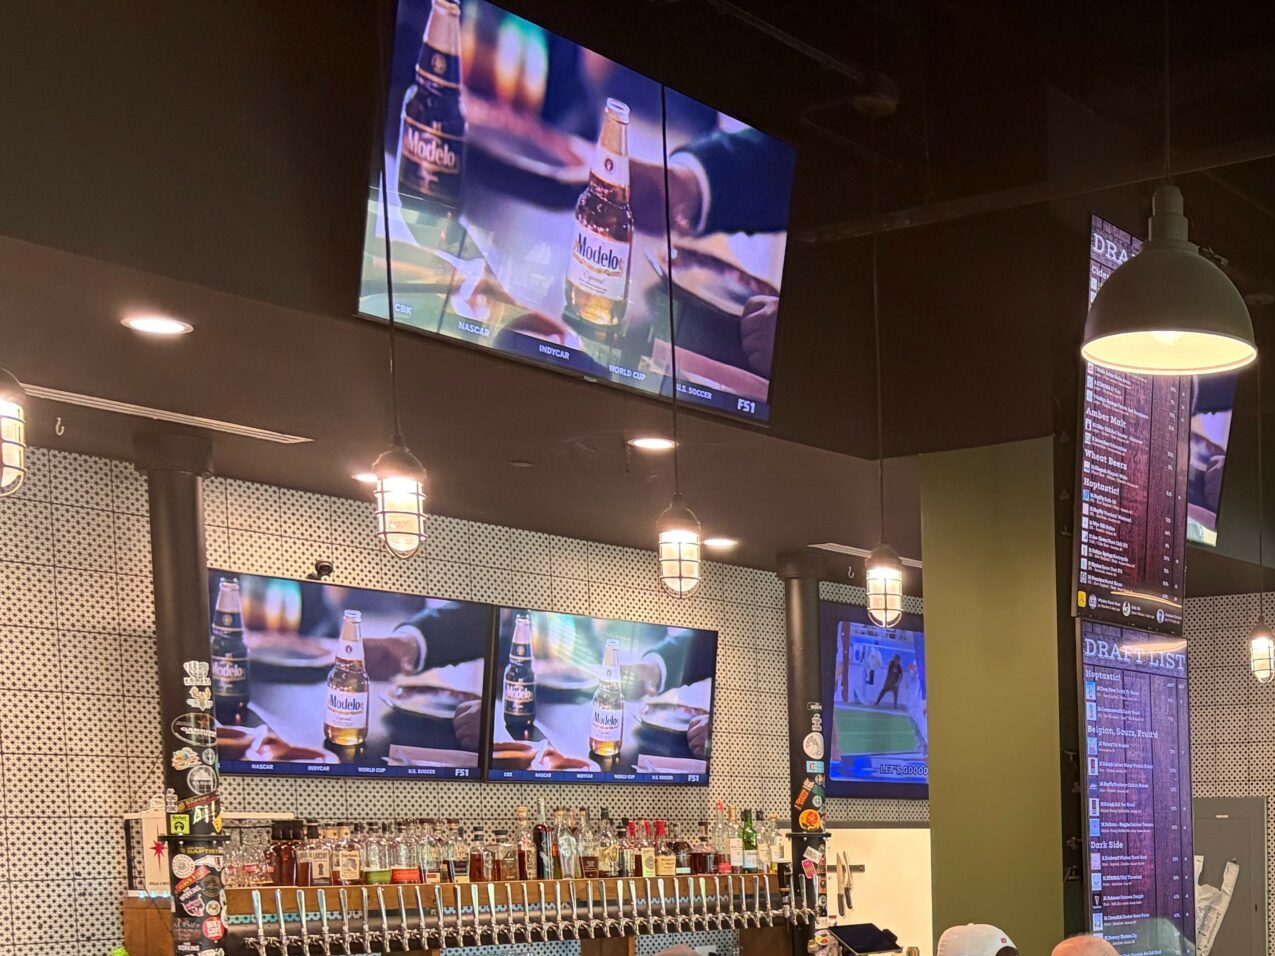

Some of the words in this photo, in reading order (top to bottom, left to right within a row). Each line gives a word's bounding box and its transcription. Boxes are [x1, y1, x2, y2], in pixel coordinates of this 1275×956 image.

[408, 127, 455, 168] Modelo
[578, 233, 619, 270] Modelo
[395, 303, 413, 315] CBK
[459, 321, 490, 337] NASCAR
[539, 344, 570, 360] INDYCAR
[609, 364, 632, 378] WORLD
[632, 369, 646, 381] CUP
[688, 387, 713, 400] SOCCER
[737, 398, 756, 414] FS1
[1085, 449, 1108, 465] Wheat
[1083, 477, 1120, 496] Hoptastic!
[1084, 638, 1143, 665] DRAFT
[1150, 652, 1186, 670] LIST
[1085, 669, 1122, 682] Hoptastic!
[506, 684, 532, 700] Modelo
[331, 694, 361, 711] Modelo
[594, 712, 618, 725] Modelo
[455, 768, 469, 777] FS1
[1090, 841, 1107, 850] Dark
[1108, 841, 1124, 849] Side
